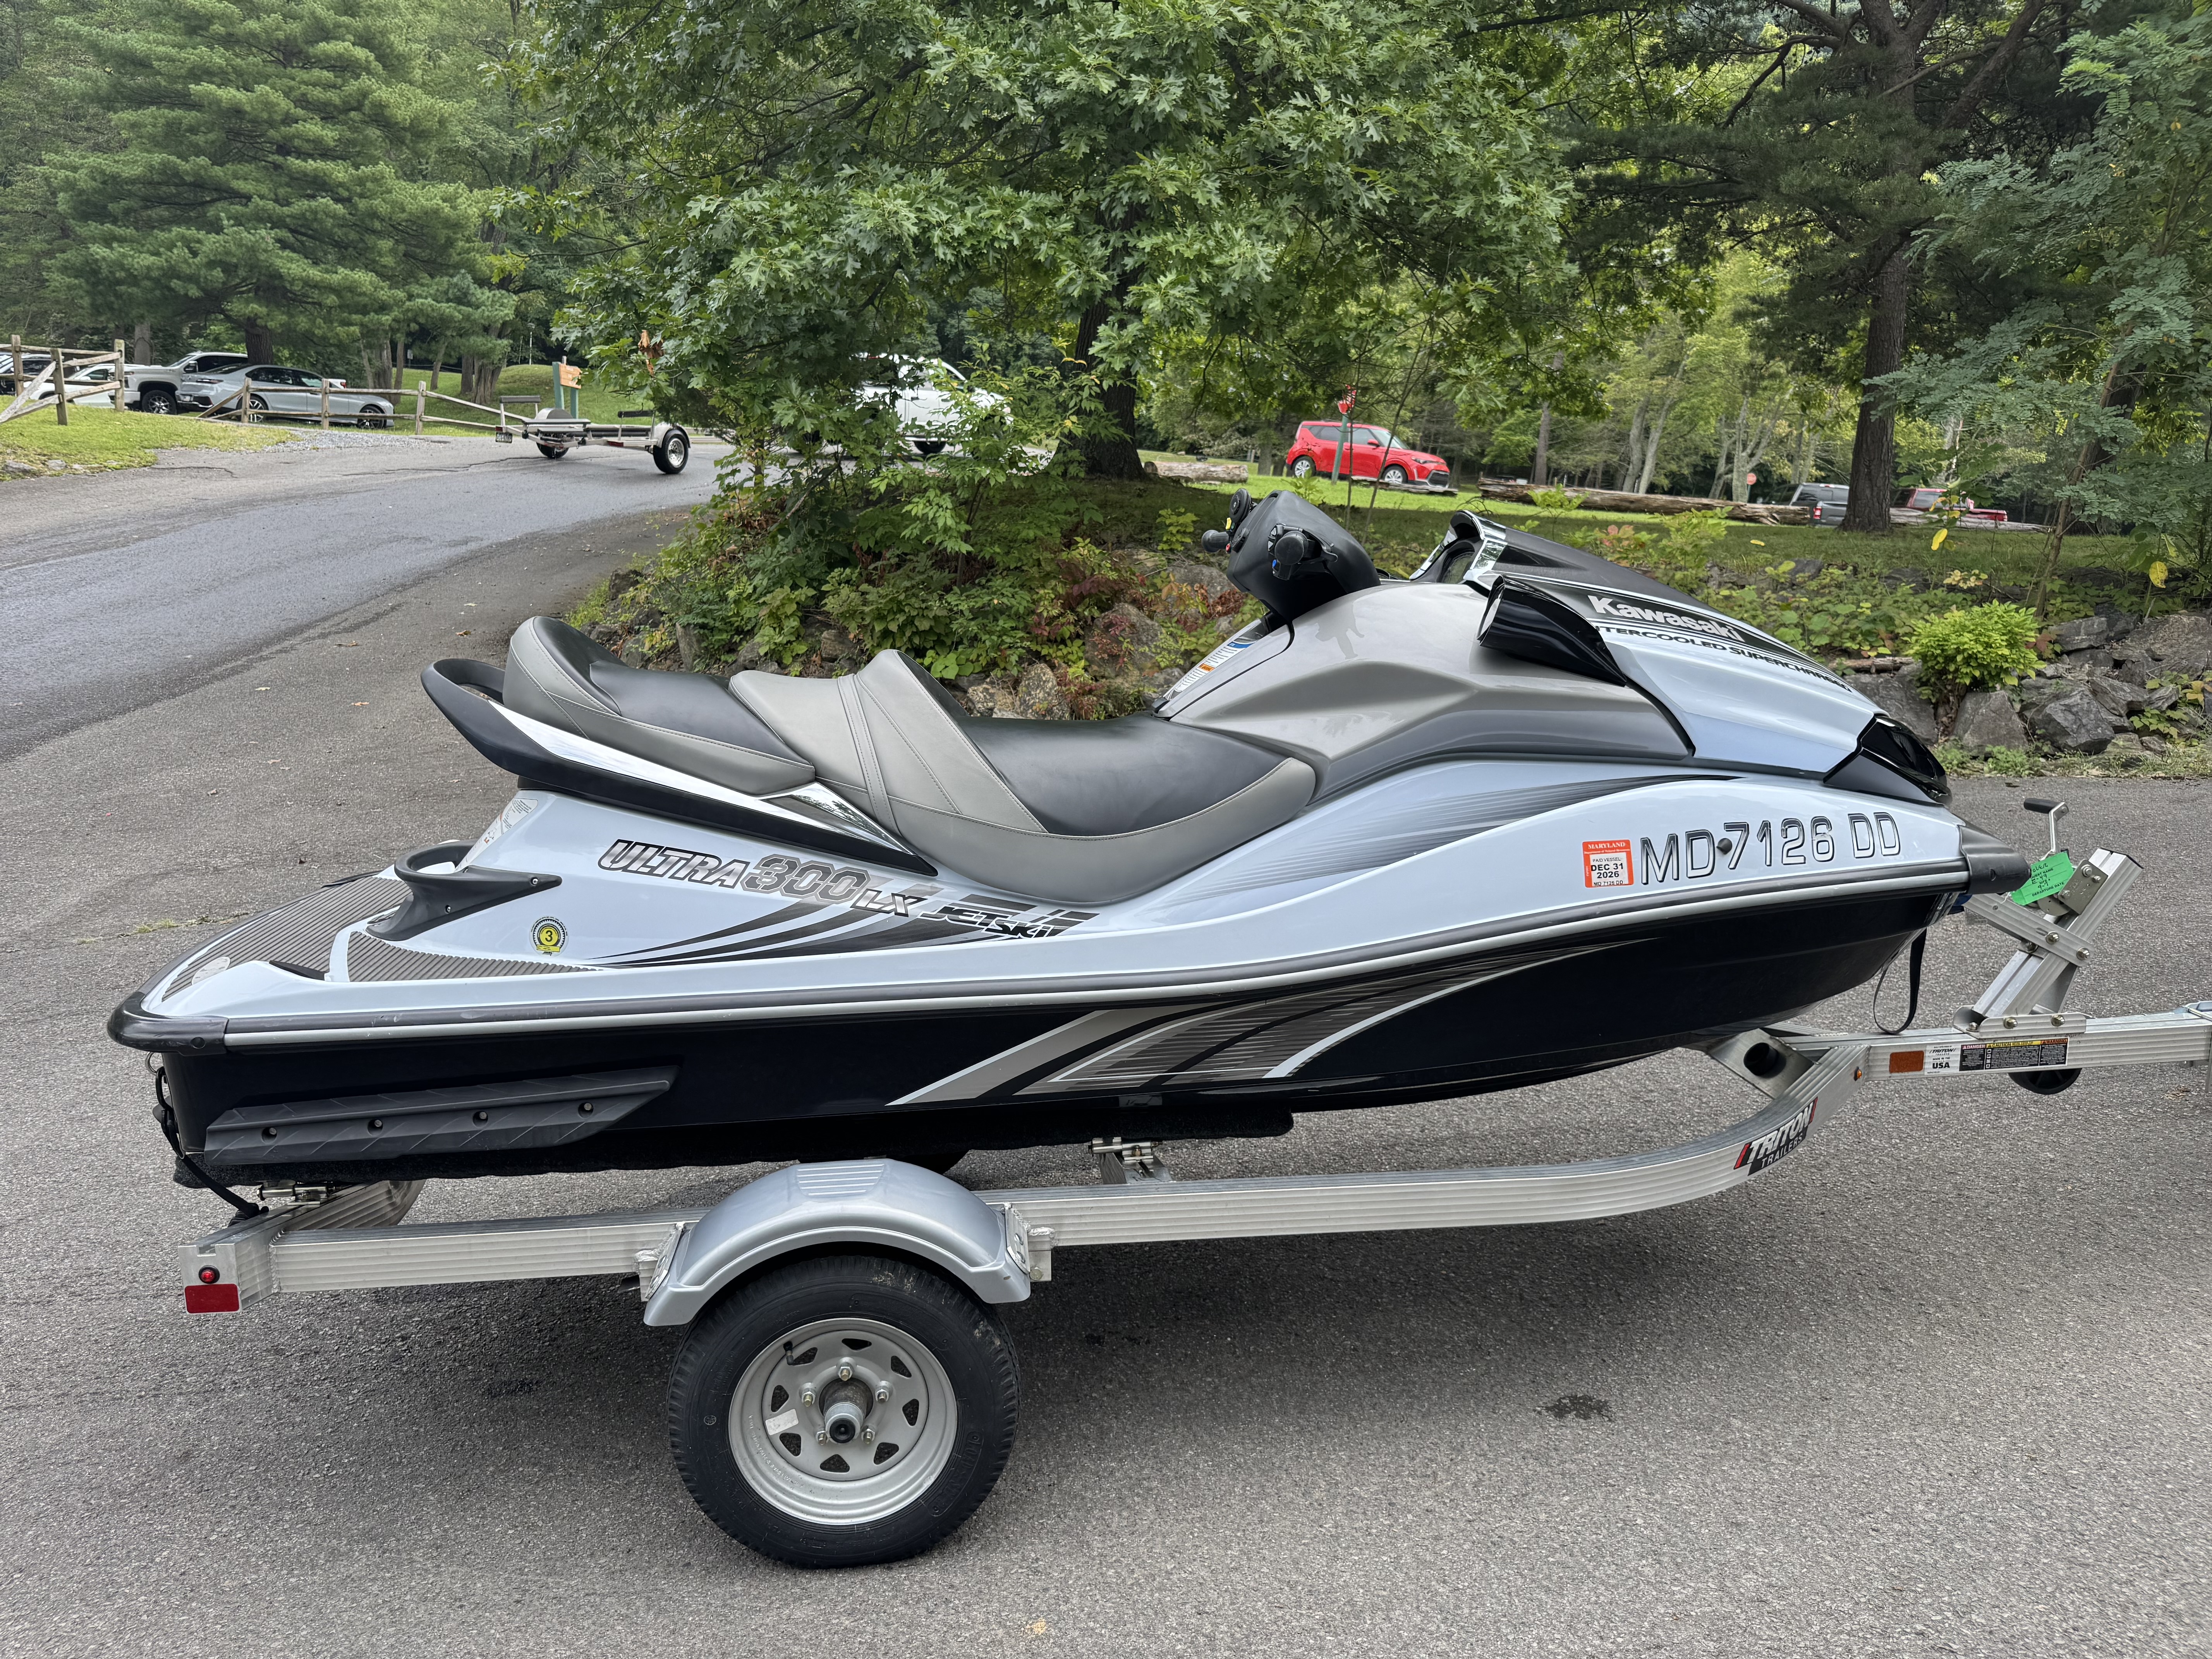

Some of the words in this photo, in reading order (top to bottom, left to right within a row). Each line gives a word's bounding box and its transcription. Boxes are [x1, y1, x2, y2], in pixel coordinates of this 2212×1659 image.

[1588, 595, 1746, 642] Kawasaki
[1729, 647, 1853, 693] SUPERCHARGED
[598, 839, 750, 889] ULTRA
[1640, 829, 1715, 885] MD
[1724, 816, 1834, 869] 7126
[1848, 812, 1901, 858] DD
[2032, 886, 2054, 896] DEPARTURE
[545, 930, 553, 942] 3
[1747, 1102, 1813, 1164] TRITON
[1762, 1133, 1803, 1168] TRAILERS
